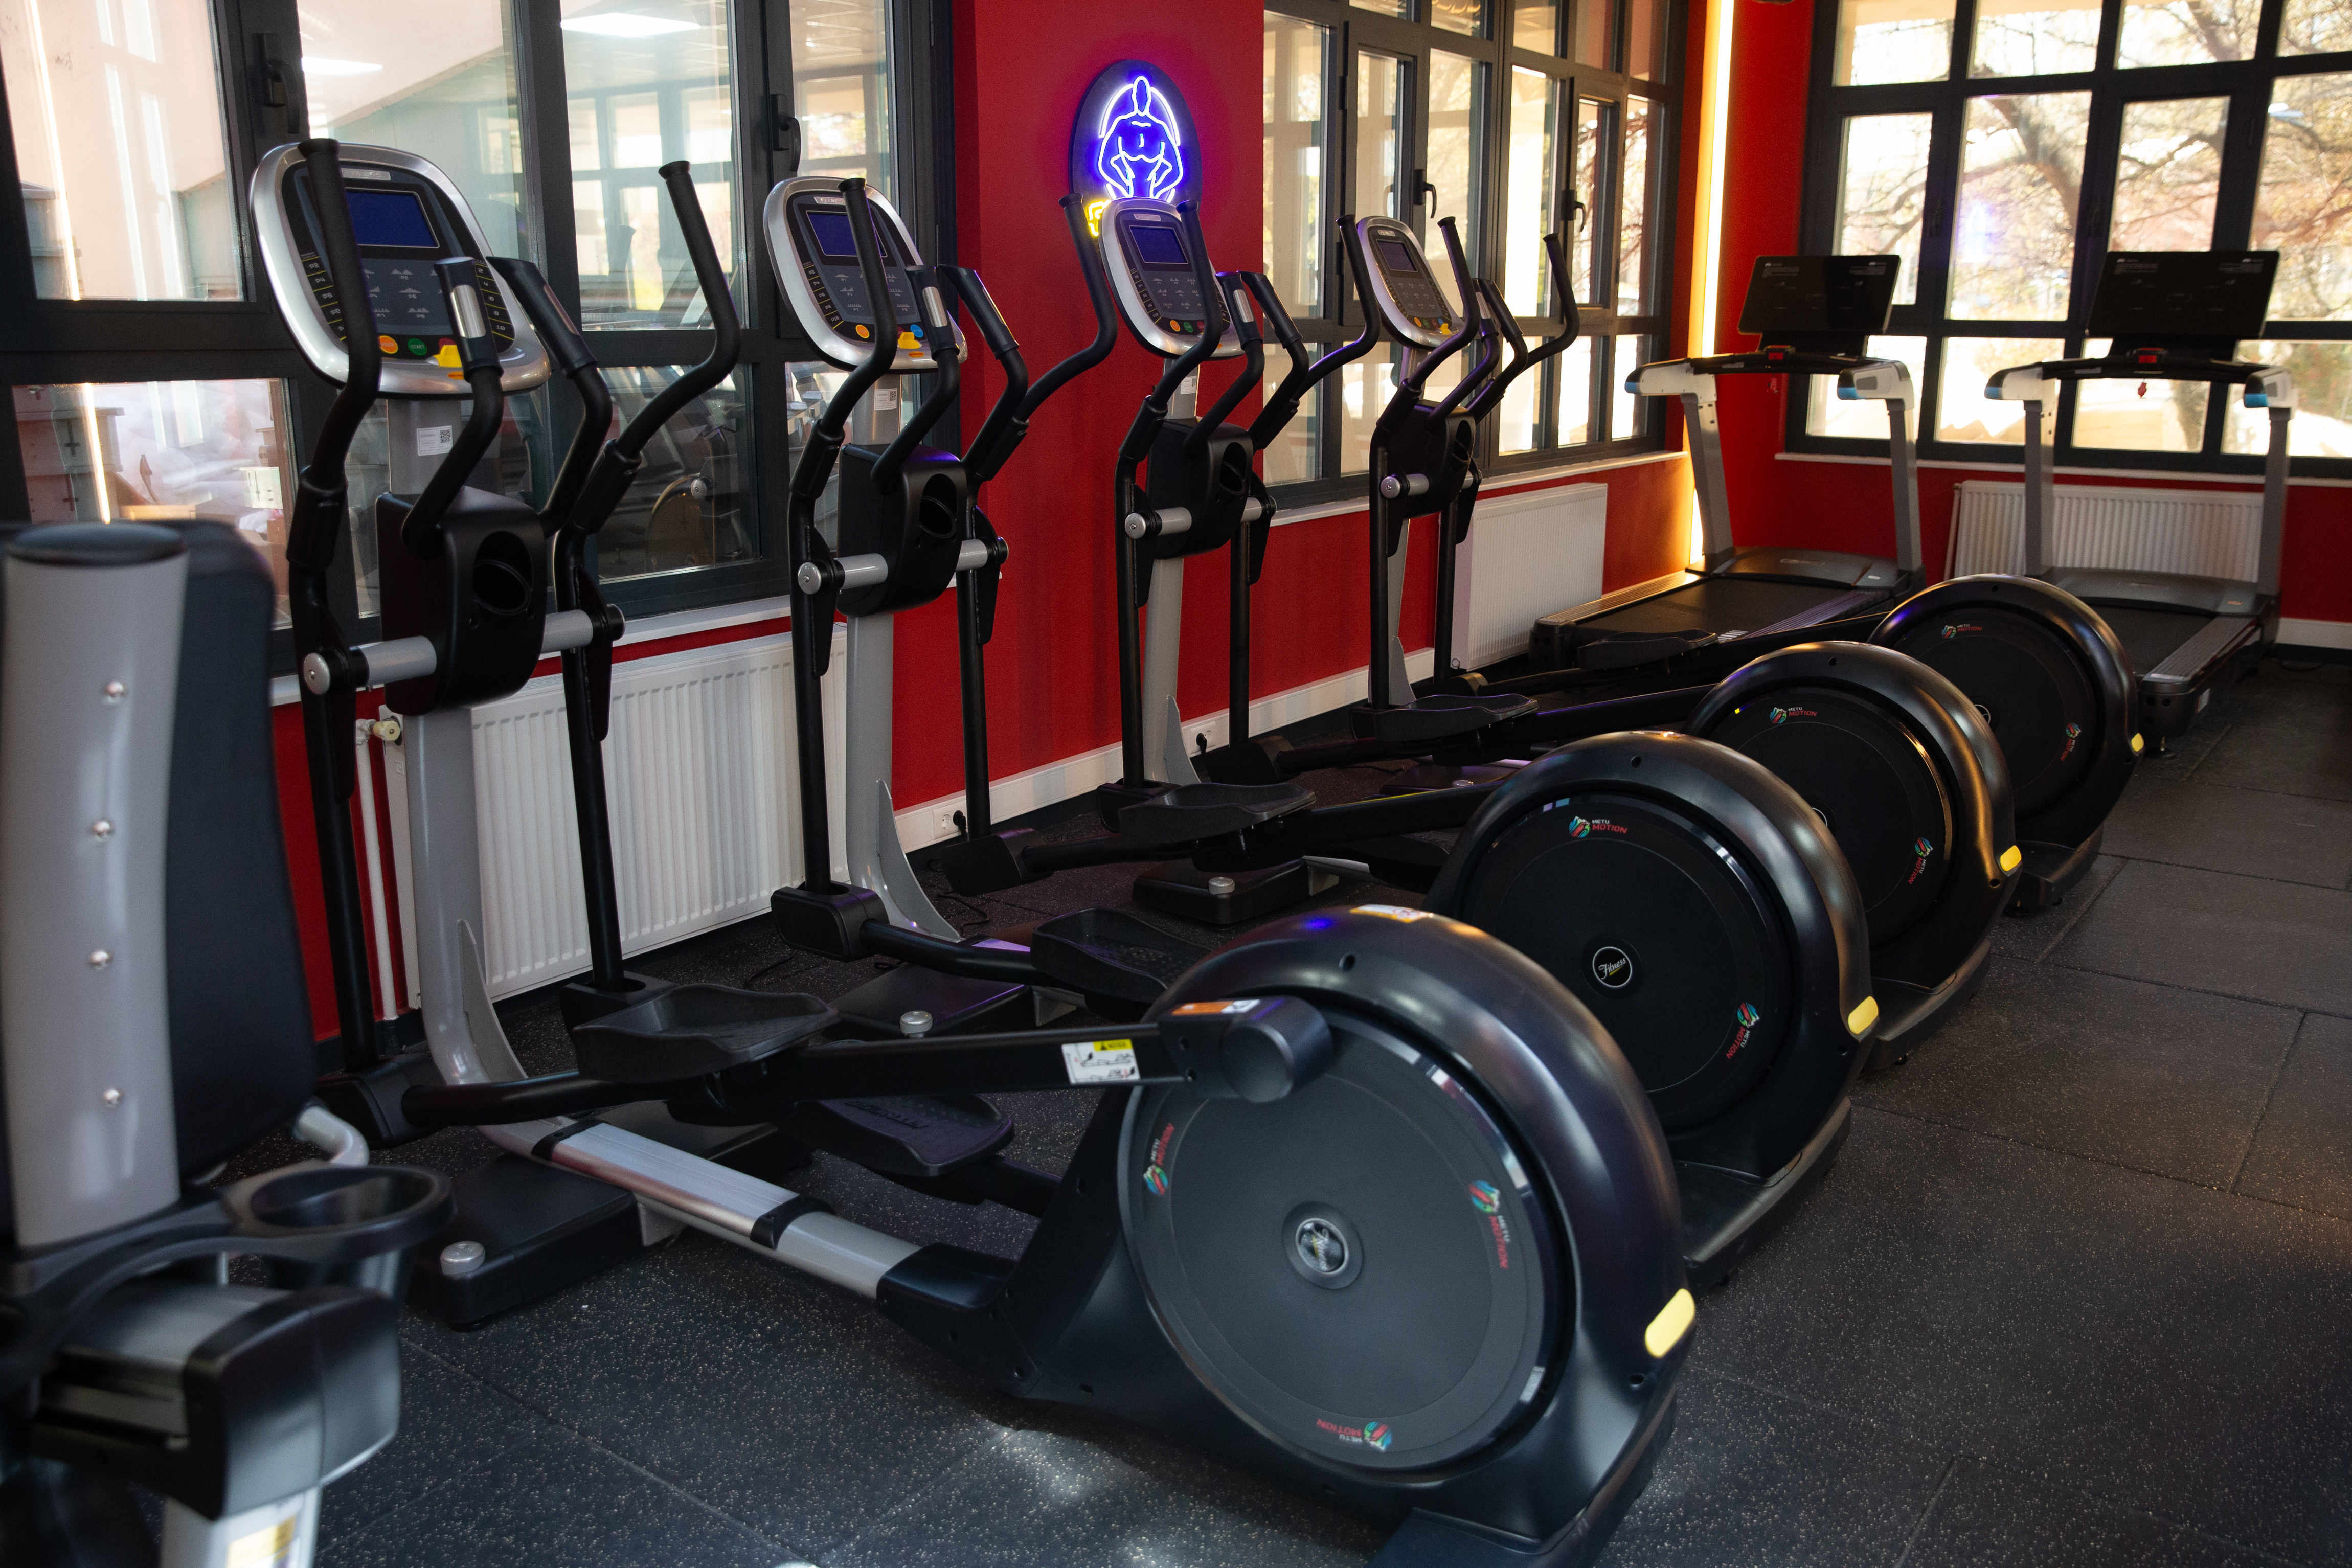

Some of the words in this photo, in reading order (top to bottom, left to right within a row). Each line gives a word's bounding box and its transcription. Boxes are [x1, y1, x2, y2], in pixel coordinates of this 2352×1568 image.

[2060, 738, 2072, 761] MOTION
[1592, 824, 1627, 834] MOTION
[1908, 857, 1923, 884] MOTION
[1598, 958, 1626, 980] Fitness
[1726, 1026, 1746, 1059] MOTION
[1740, 1030, 1750, 1048] METU
[1498, 1215, 1511, 1242] METU
[1488, 1215, 1509, 1269] MOTION
[1317, 1419, 1362, 1436] MOTION
